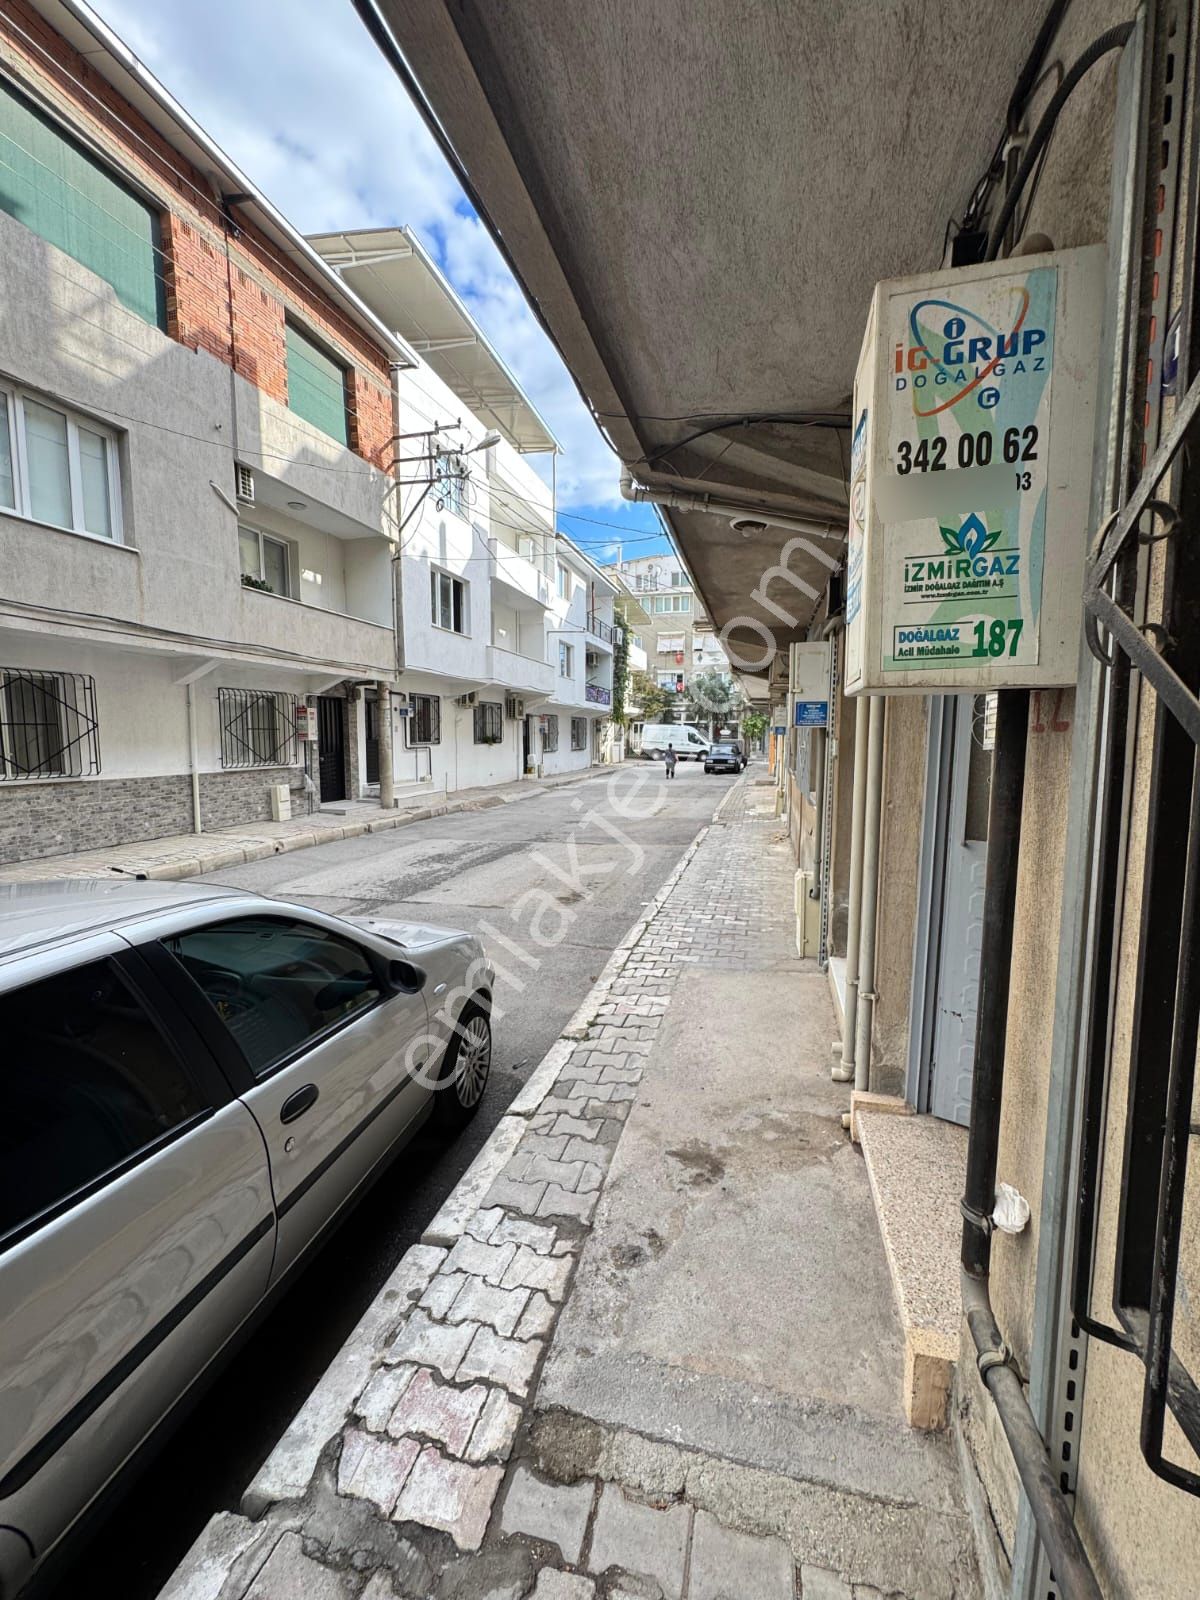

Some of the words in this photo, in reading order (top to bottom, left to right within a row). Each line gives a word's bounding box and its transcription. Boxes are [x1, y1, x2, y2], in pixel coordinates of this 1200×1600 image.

[896, 357, 1045, 391] DOĞALGAZ
[897, 436, 947, 475] 342
[958, 431, 992, 468] 00
[1003, 425, 1038, 463] 62
[904, 583, 923, 593] İZMİR
[925, 581, 961, 592] DOĞALGAZ
[962, 579, 991, 589] DAĞITIM
[898, 627, 960, 644] DOĞALGAZ
[972, 618, 1024, 658] 187
[898, 646, 914, 657] Acil
[916, 645, 960, 656] Müdahale
